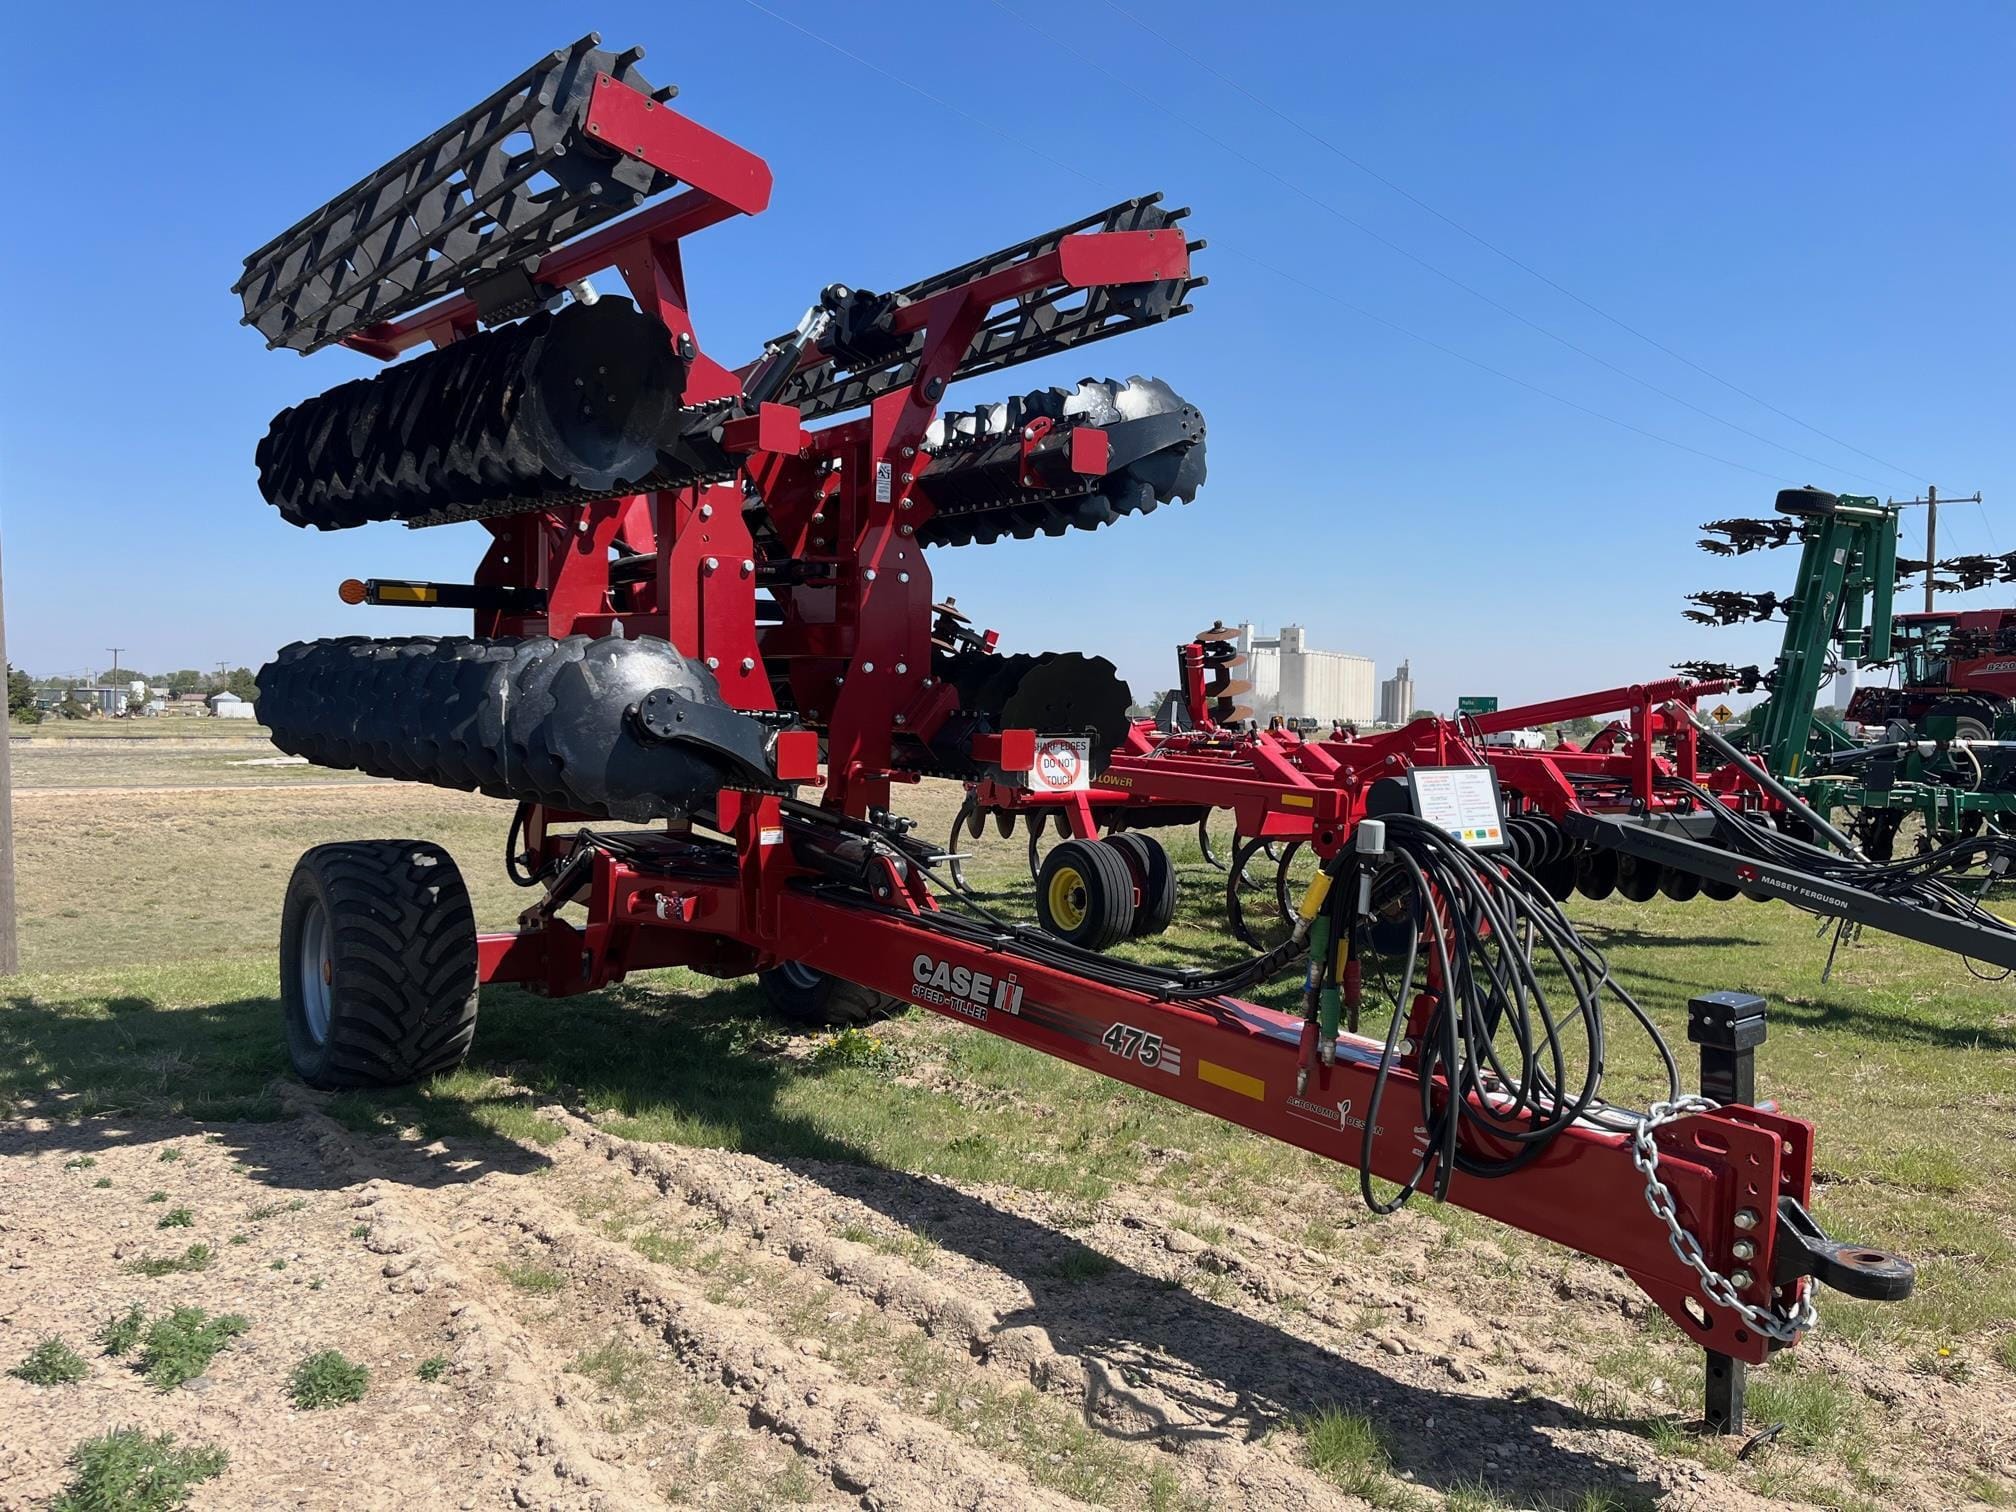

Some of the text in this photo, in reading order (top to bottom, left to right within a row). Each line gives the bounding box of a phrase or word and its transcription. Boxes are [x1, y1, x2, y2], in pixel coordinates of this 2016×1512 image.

[1986, 661, 2016, 673] 8250
[1043, 758, 1074, 768] DO NOT
[1060, 741, 1087, 751] EDGES
[1046, 776, 1073, 786] TOUCH
[1761, 875, 1849, 910] MASSEY FERGUSON
[912, 953, 993, 1005] CASE
[911, 983, 988, 1022] SPEED-TILLER
[1101, 1021, 1163, 1068] 475
[1286, 1096, 1385, 1136] AGRONOMIC DESN
